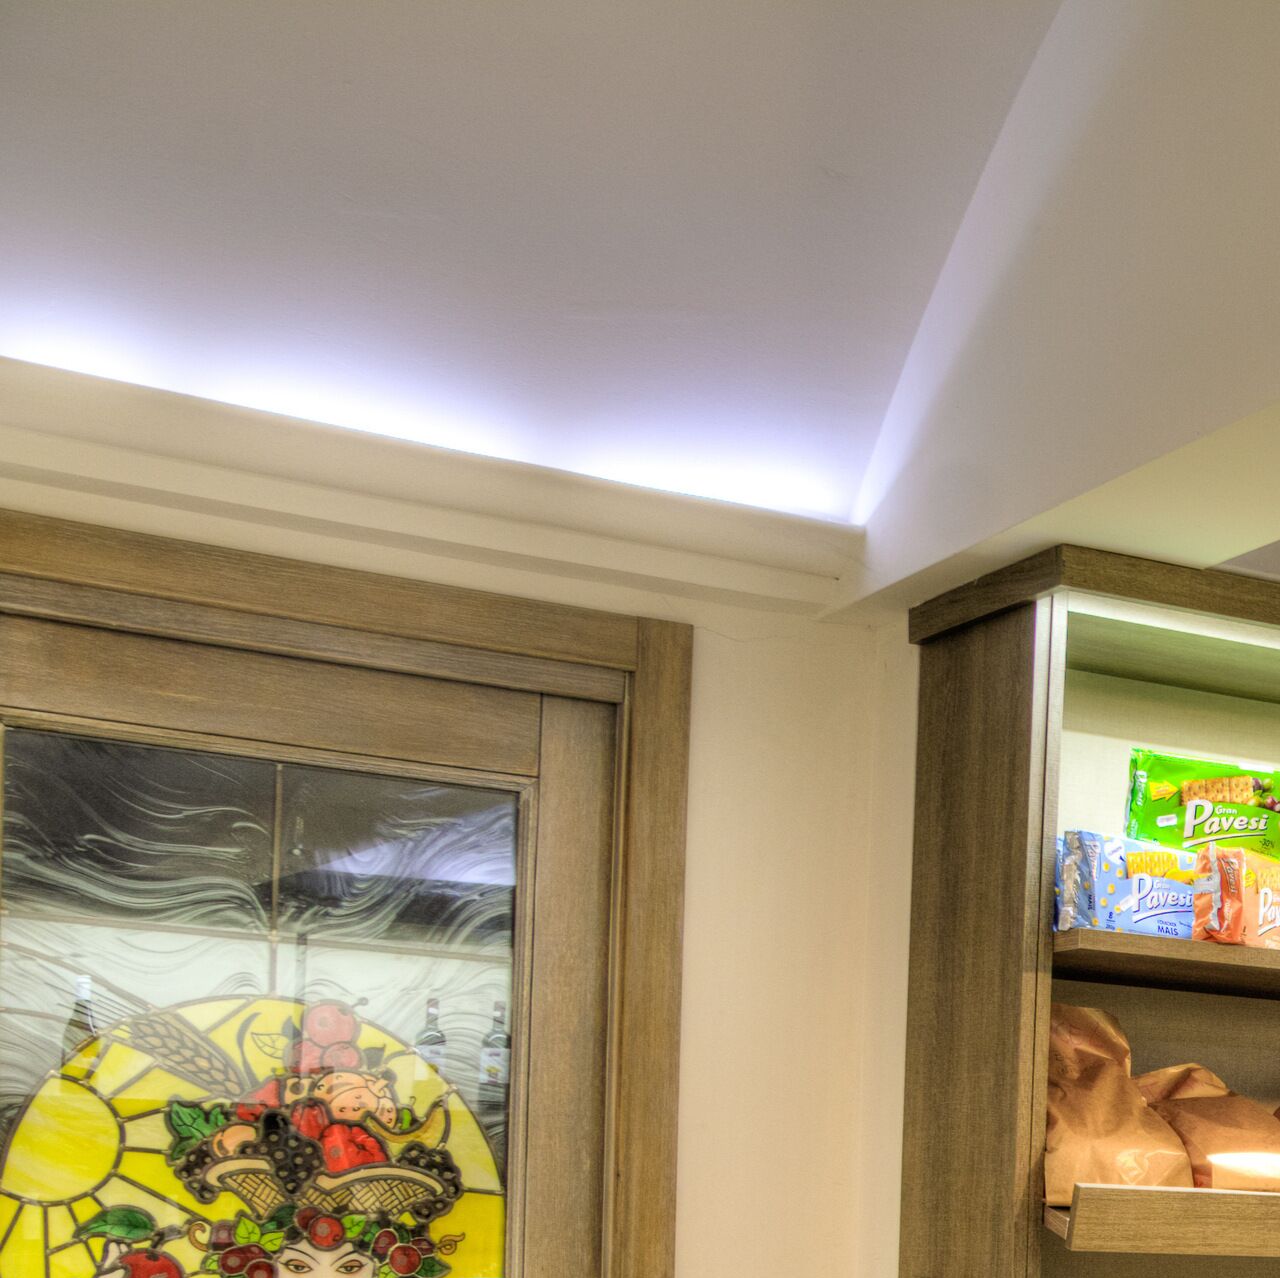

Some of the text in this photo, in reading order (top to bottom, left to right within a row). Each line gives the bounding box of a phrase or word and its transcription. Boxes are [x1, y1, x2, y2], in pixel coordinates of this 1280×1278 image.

[1183, 799, 1268, 839] Pavesi
[1215, 806, 1238, 815] Gran
[1132, 873, 1193, 914] Pavesi
[1157, 925, 1179, 936] MAIS
